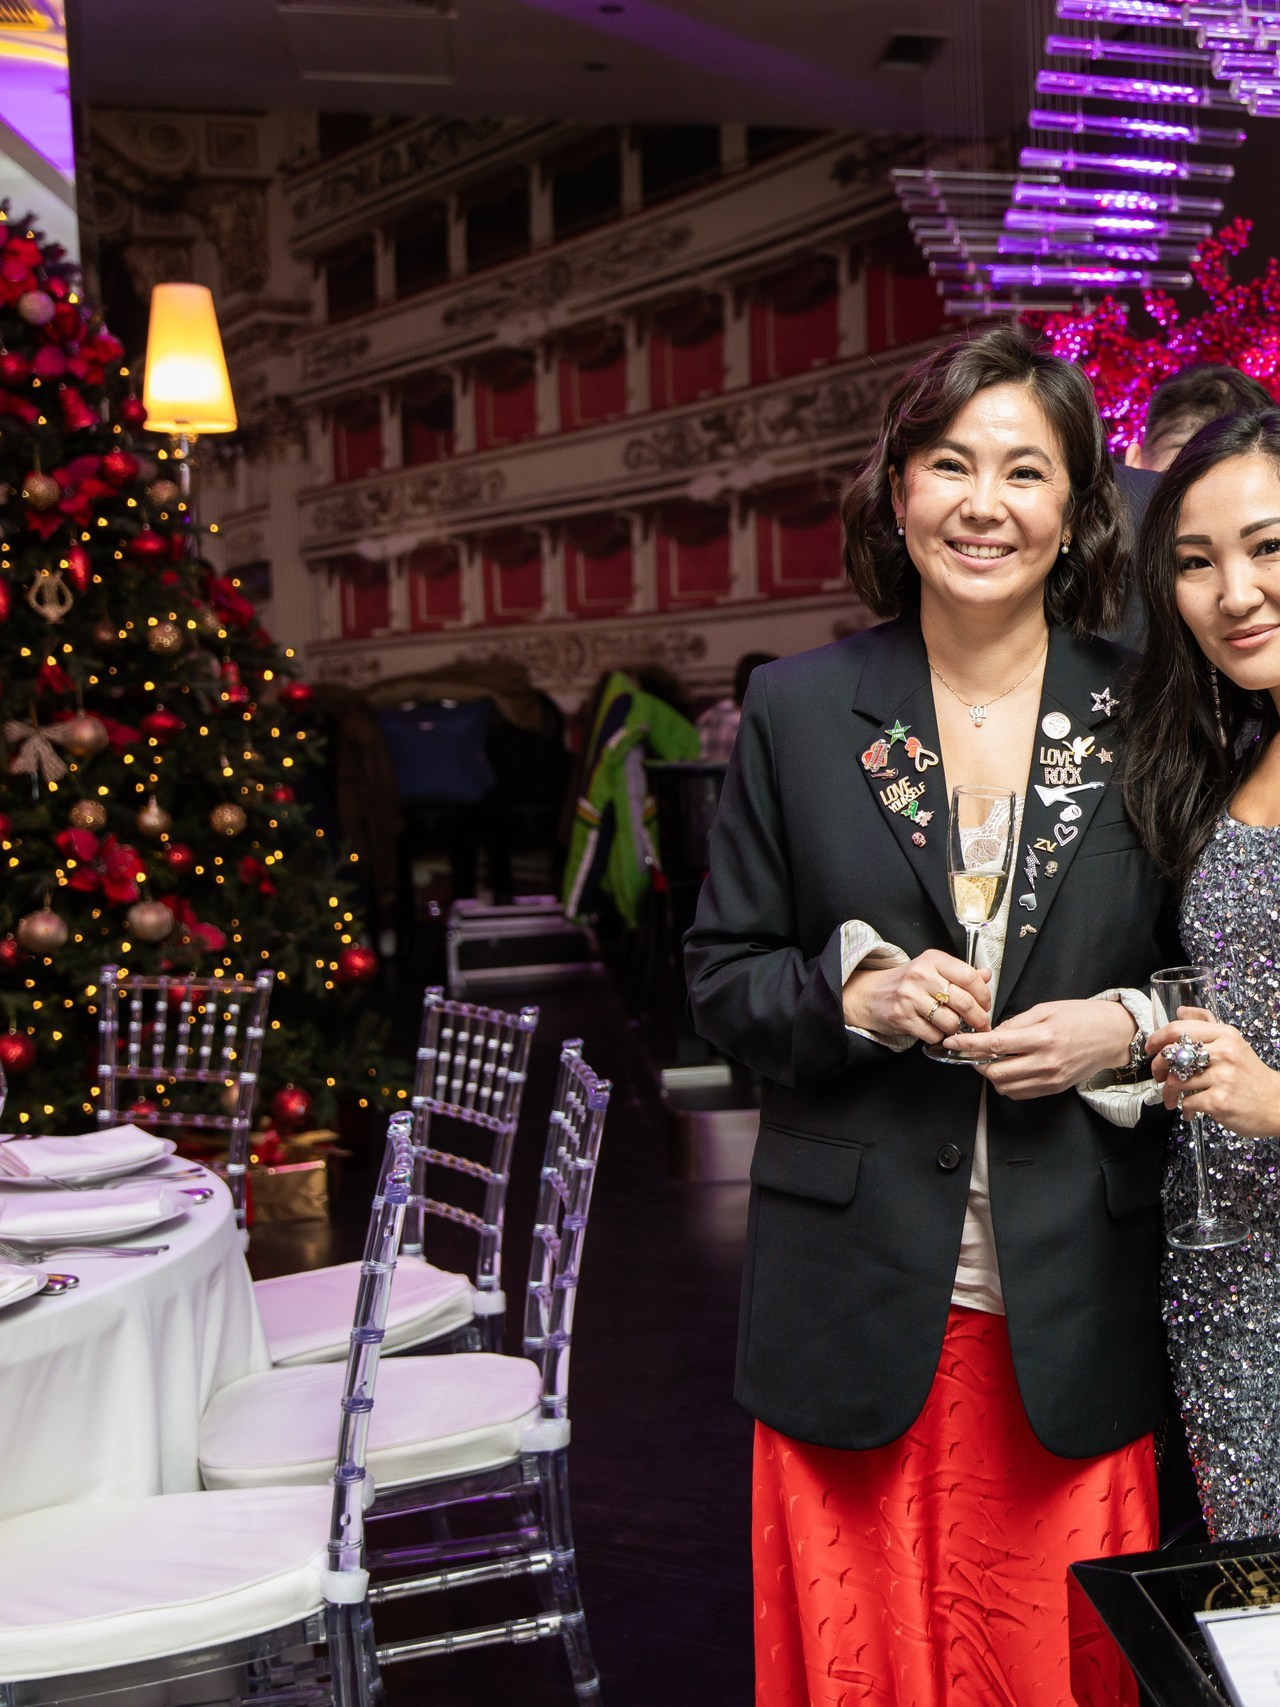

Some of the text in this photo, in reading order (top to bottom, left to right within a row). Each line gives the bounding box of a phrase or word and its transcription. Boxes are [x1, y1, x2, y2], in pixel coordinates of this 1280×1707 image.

[1039, 747, 1074, 767] LOVE
[1045, 767, 1082, 785] ROCK
[879, 776, 911, 806] LOVE
[888, 781, 926, 813] YOURSELF
